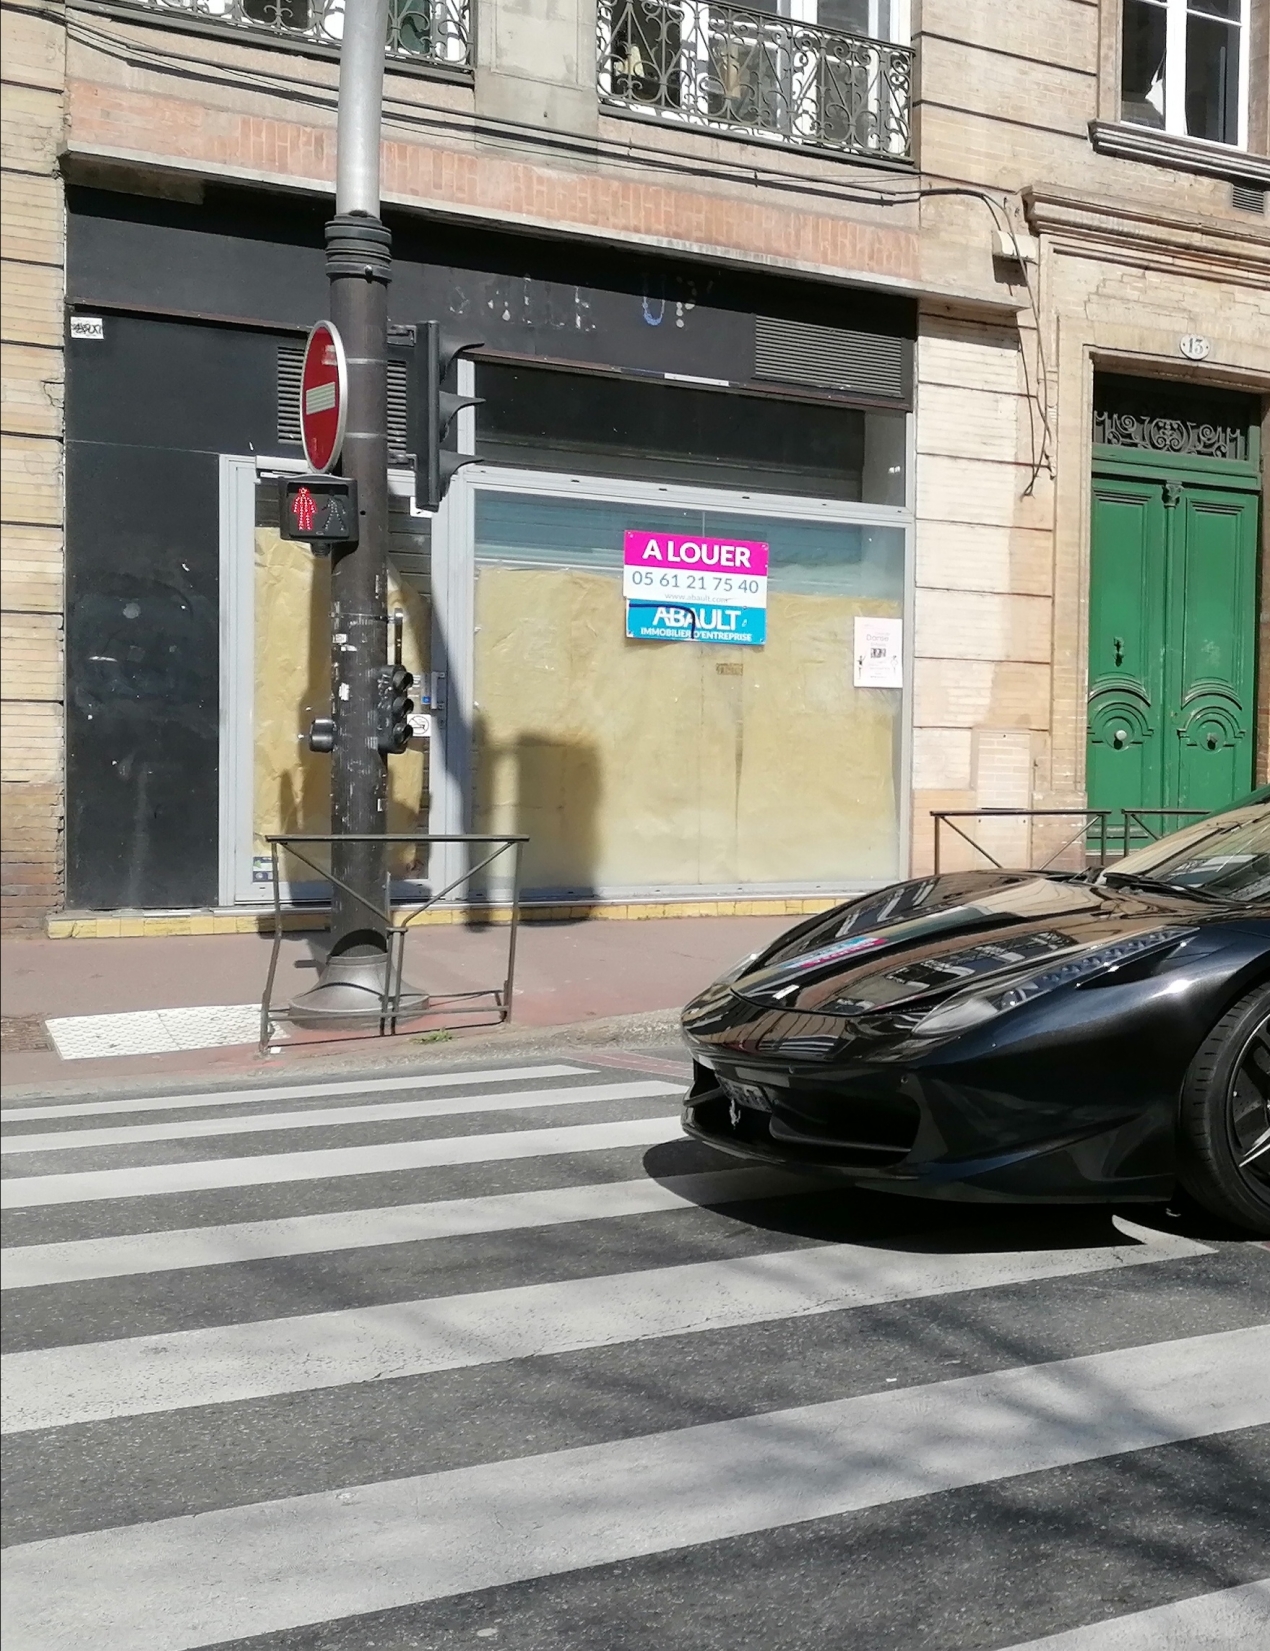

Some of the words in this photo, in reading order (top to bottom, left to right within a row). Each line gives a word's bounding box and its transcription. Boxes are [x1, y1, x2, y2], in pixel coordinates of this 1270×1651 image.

[1189, 337, 1204, 355] 13
[642, 539, 663, 561] A
[667, 540, 751, 568] LOUER
[632, 570, 654, 586] 05
[659, 573, 680, 588] 61
[686, 575, 706, 590] 21
[712, 577, 733, 592] 75
[738, 579, 759, 594] 40
[664, 592, 728, 603] www.abault.com
[652, 606, 741, 631] ABAULT
[640, 626, 692, 639] IMMOBILIER
[693, 629, 753, 642] D'ENTREPRISE
